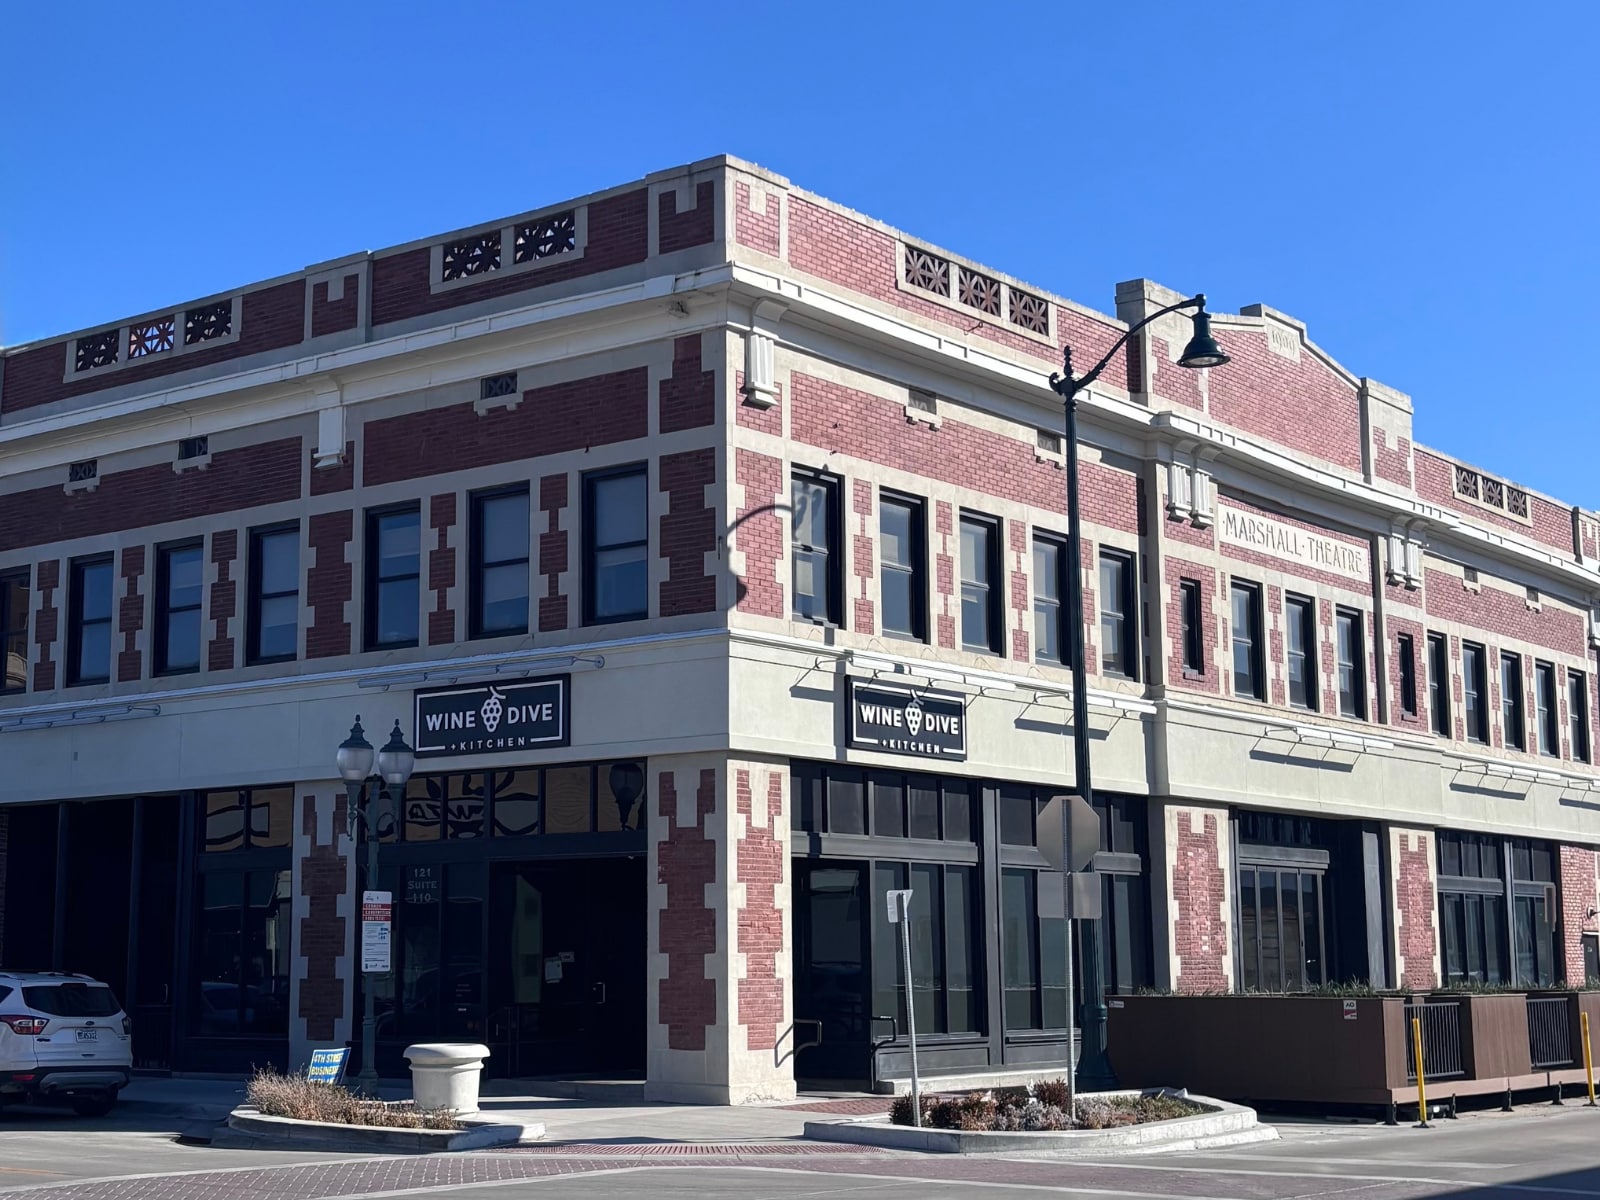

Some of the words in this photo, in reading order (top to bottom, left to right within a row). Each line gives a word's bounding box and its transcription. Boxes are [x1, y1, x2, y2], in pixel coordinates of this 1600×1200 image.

[1225, 511, 1302, 557] MARSHALL
[1307, 536, 1363, 574] THEATRE
[425, 710, 476, 731] WINE
[507, 703, 553, 724] DIVE
[860, 704, 902, 728] WINE
[925, 713, 959, 735] DIVE
[407, 880, 438, 889] SUITE
[414, 868, 431, 877] 121
